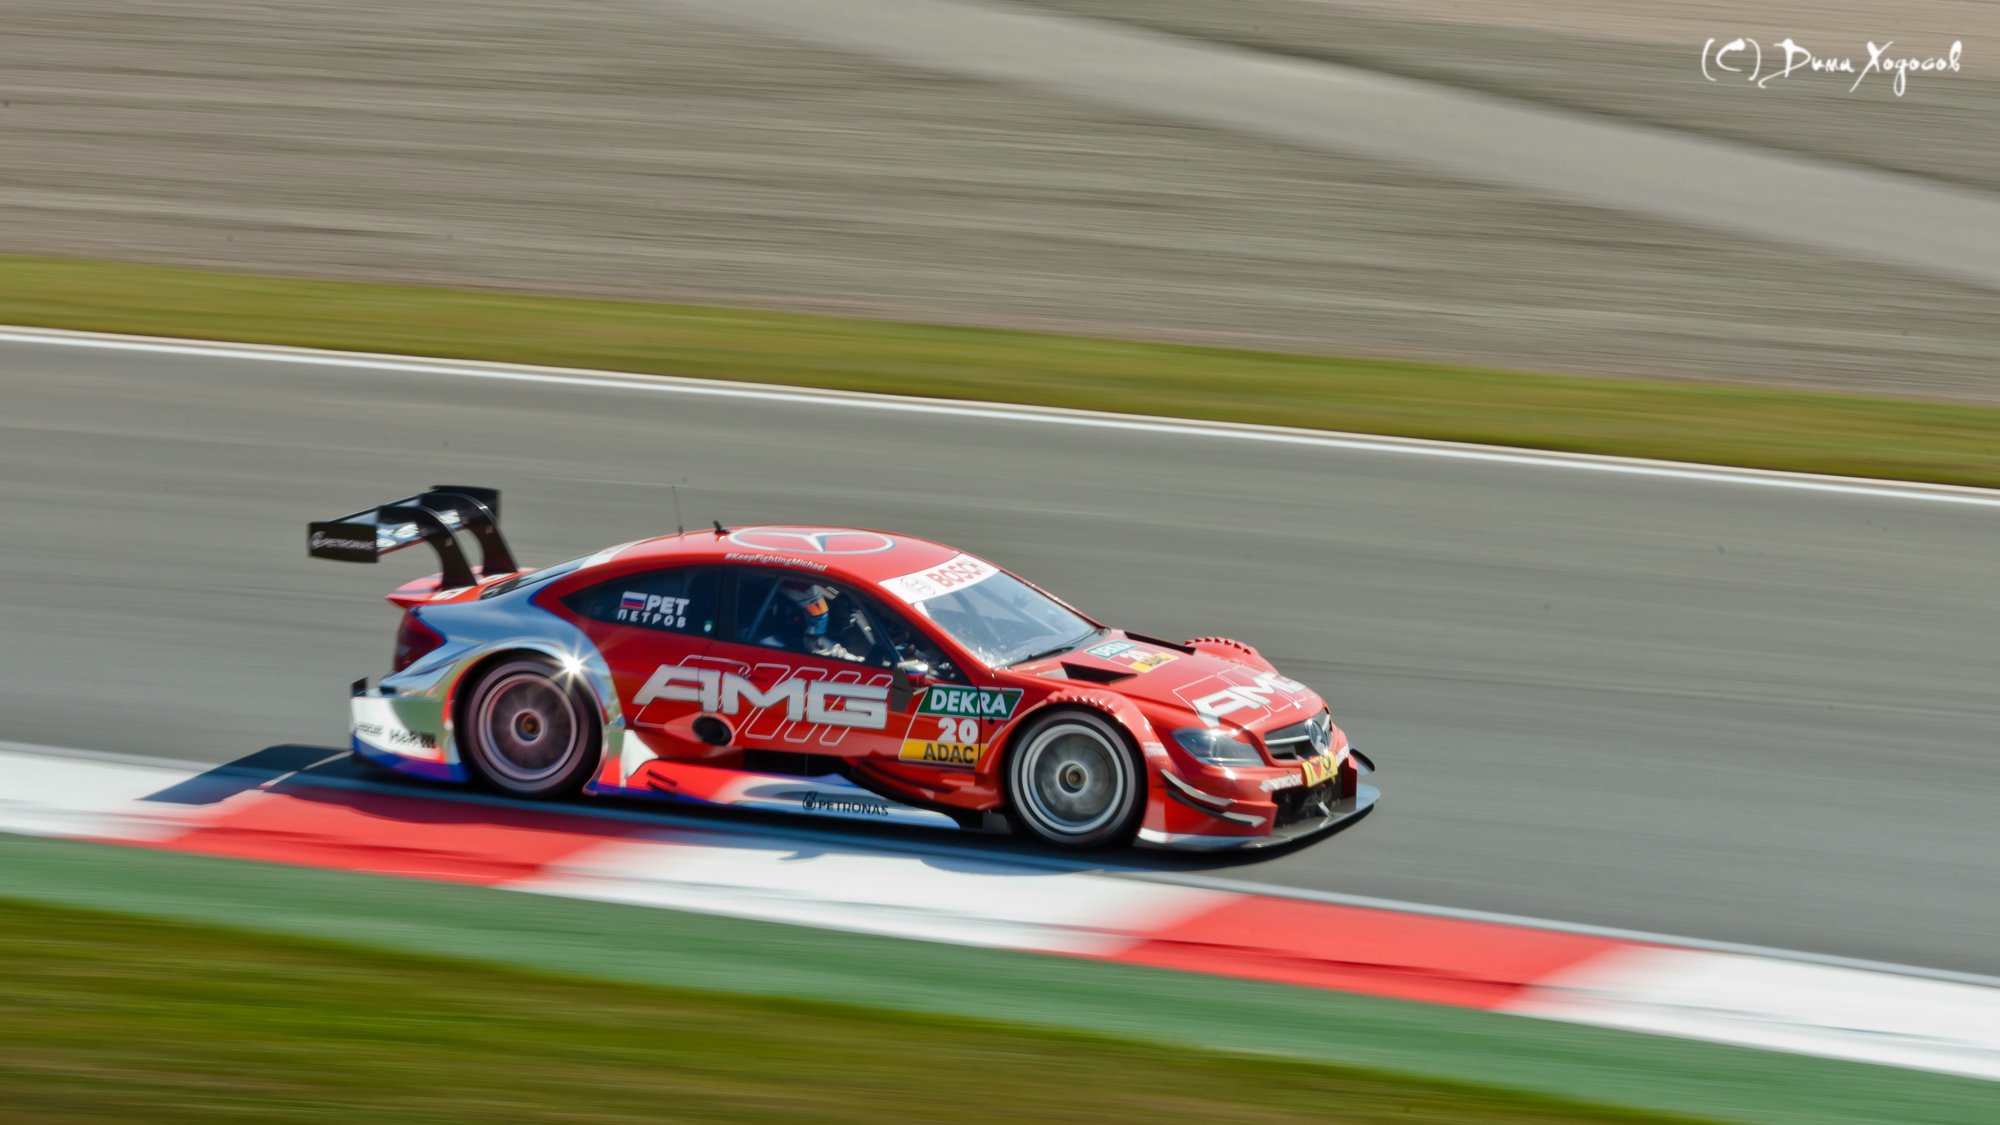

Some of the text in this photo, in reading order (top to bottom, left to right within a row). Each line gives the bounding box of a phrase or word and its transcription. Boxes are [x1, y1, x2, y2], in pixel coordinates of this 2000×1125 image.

[725, 552, 828, 571] #KeepFightingMichael
[617, 608, 686, 628] ПЕТРОВ
[632, 664, 889, 729] AMG
[929, 688, 1007, 714] DEKRA
[937, 717, 979, 746] 20
[923, 743, 974, 764] ADAC
[818, 799, 889, 815] PETRONAS
